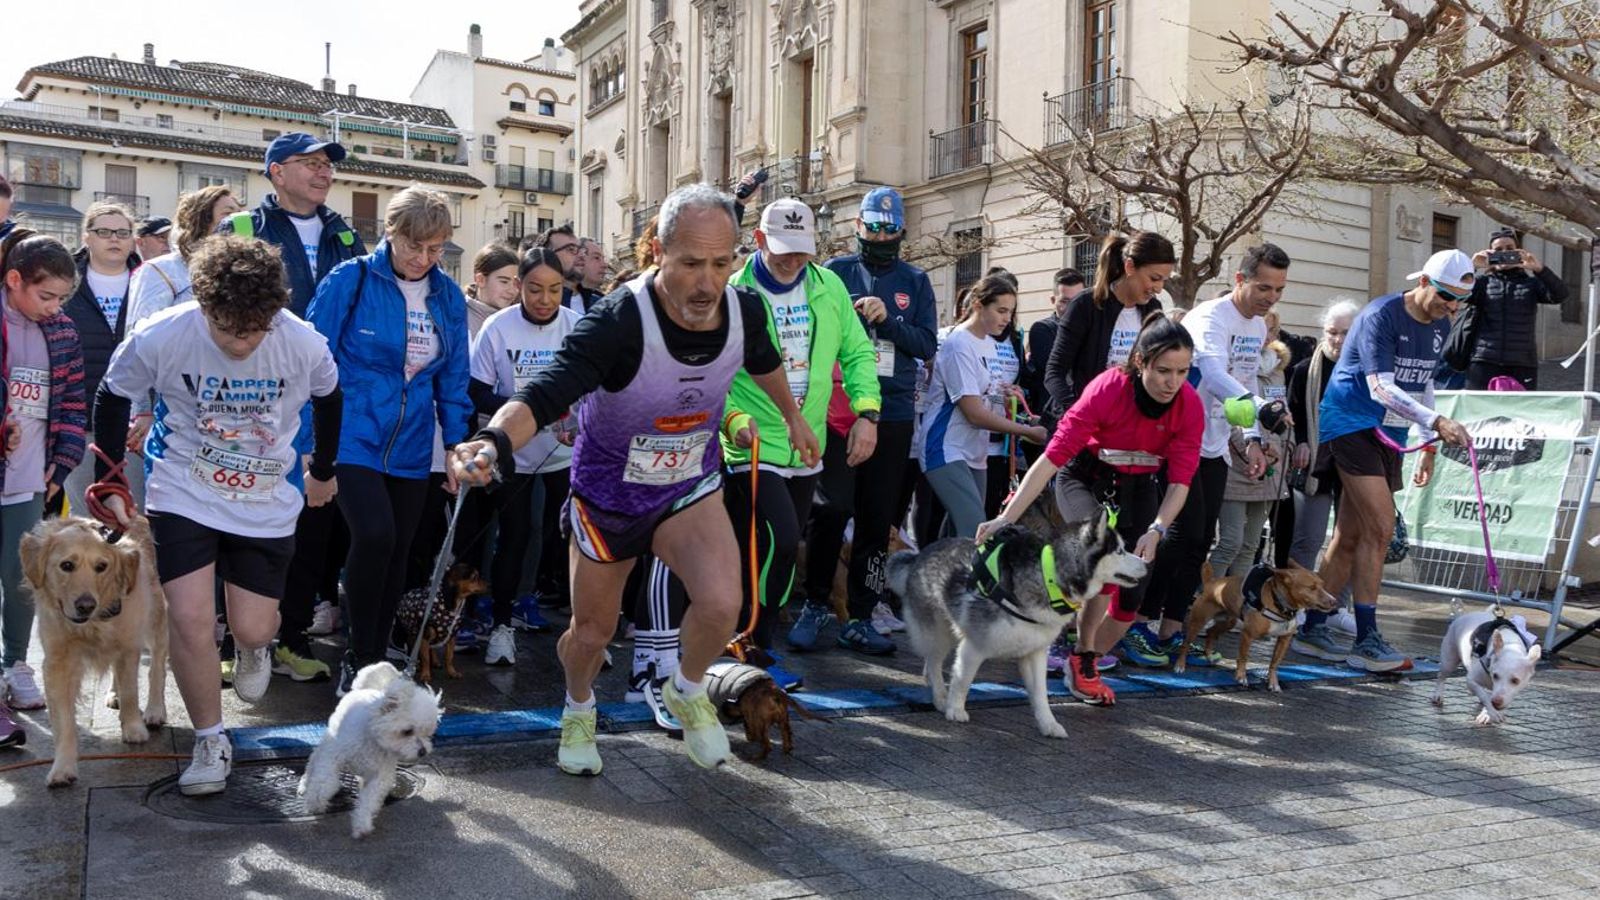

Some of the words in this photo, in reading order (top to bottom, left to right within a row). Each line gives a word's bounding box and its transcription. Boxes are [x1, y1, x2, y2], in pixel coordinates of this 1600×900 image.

[776, 305, 809, 315] CARR
[524, 350, 552, 359] CARR
[181, 373, 202, 398] V
[206, 376, 286, 391] CARRERA
[201, 388, 284, 404] CAMINATA
[636, 436, 648, 447] V
[202, 446, 213, 457] V
[652, 451, 691, 469] 737
[213, 468, 256, 489] 663
[1453, 500, 1513, 525] VERDAD
